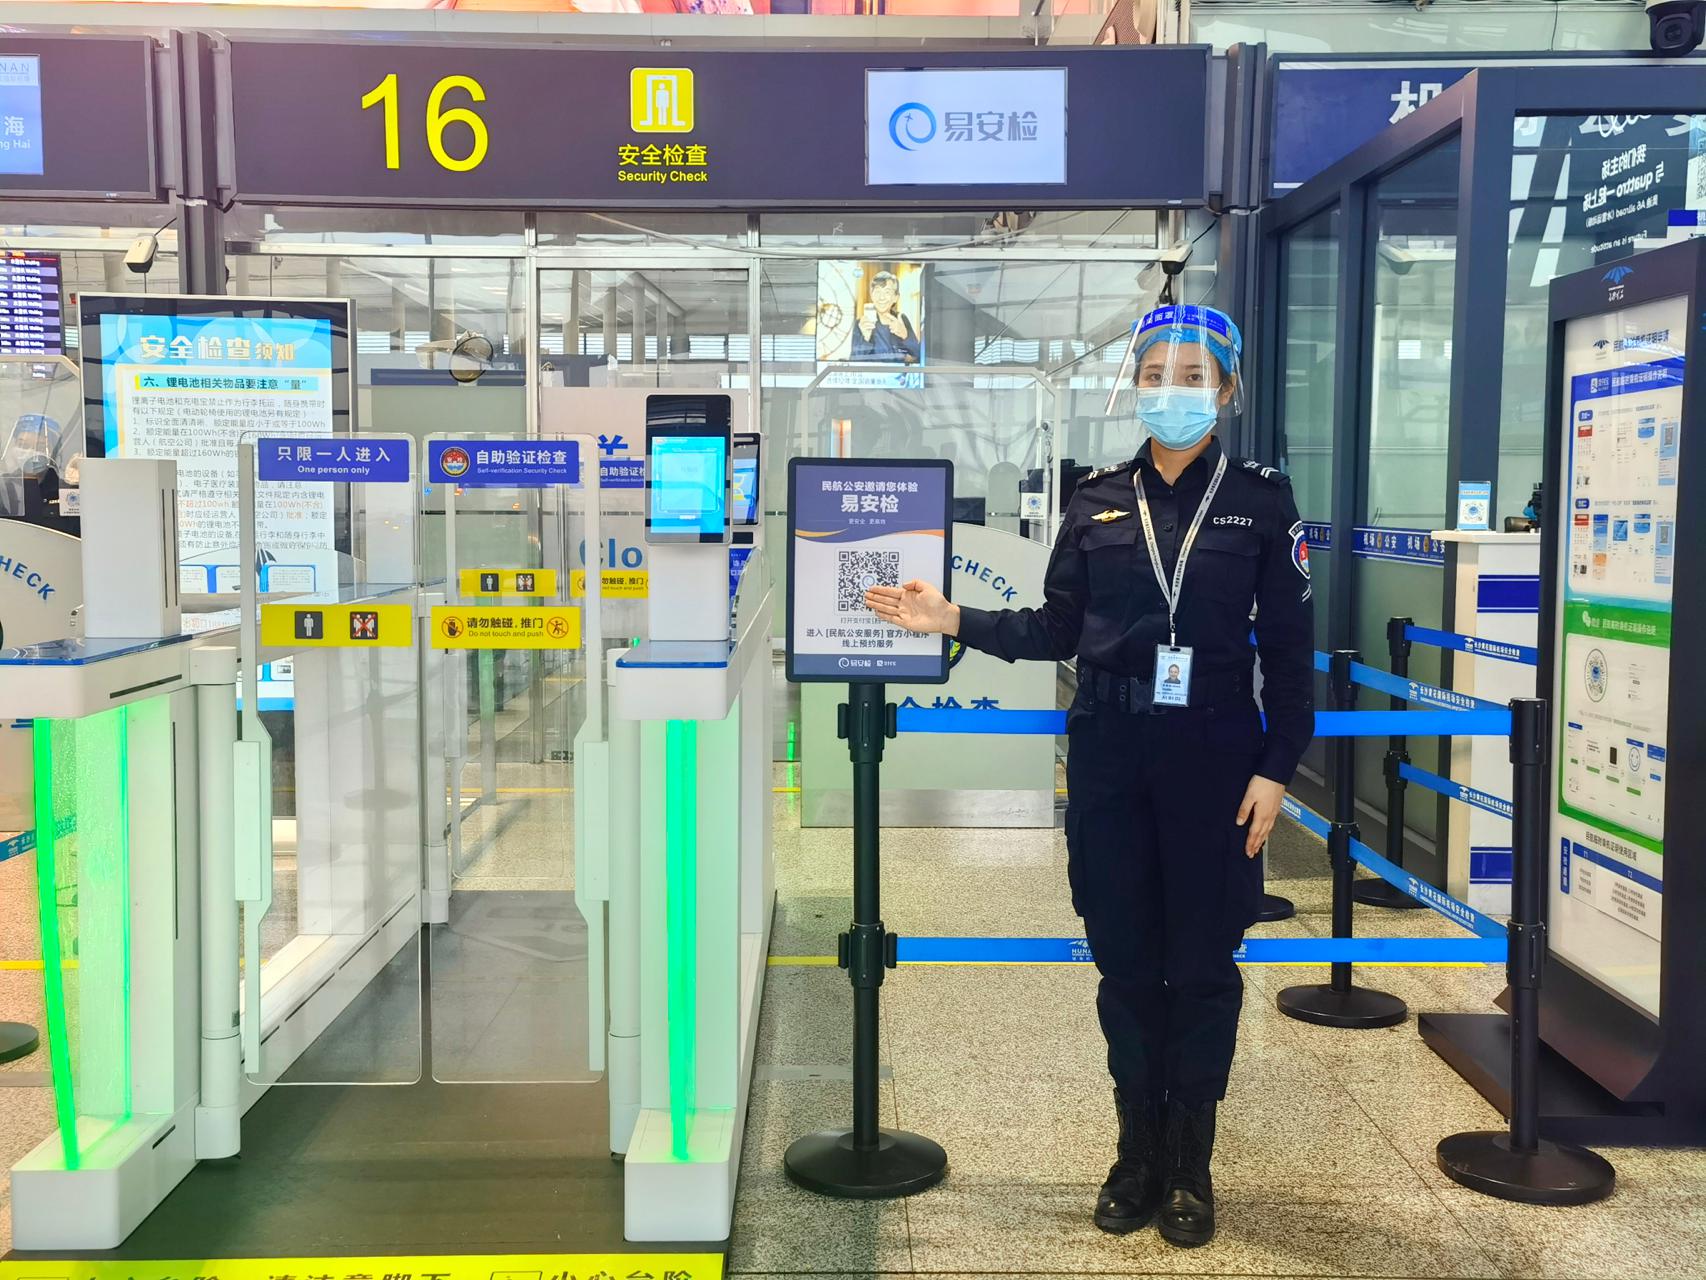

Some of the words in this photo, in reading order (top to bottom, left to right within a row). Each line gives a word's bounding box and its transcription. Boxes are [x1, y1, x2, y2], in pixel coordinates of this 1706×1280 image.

[4, 116, 25, 137] 海
[361, 73, 489, 172] 16
[944, 111, 1038, 142] 易安检
[13, 139, 31, 150] Hai
[618, 145, 708, 167] 安全检查
[618, 170, 667, 184] Security
[669, 170, 708, 183] Check
[140, 335, 296, 362] 安全检查须知
[277, 446, 391, 463] 只限一人进入
[476, 449, 567, 465] 自助验证检查
[297, 465, 316, 474] One
[317, 466, 349, 475] person
[350, 465, 370, 476] only
[523, 467, 548, 475] Security
[821, 480, 919, 493] 民航公安邀请您体验
[841, 493, 899, 513] 易安检
[1213, 515, 1253, 527] CS2227
[951, 555, 1018, 602] CHECK
[806, 628, 824, 638] 进入
[826, 628, 884, 638] [民航公安服务]
[842, 639, 894, 649] 线上预约服务
